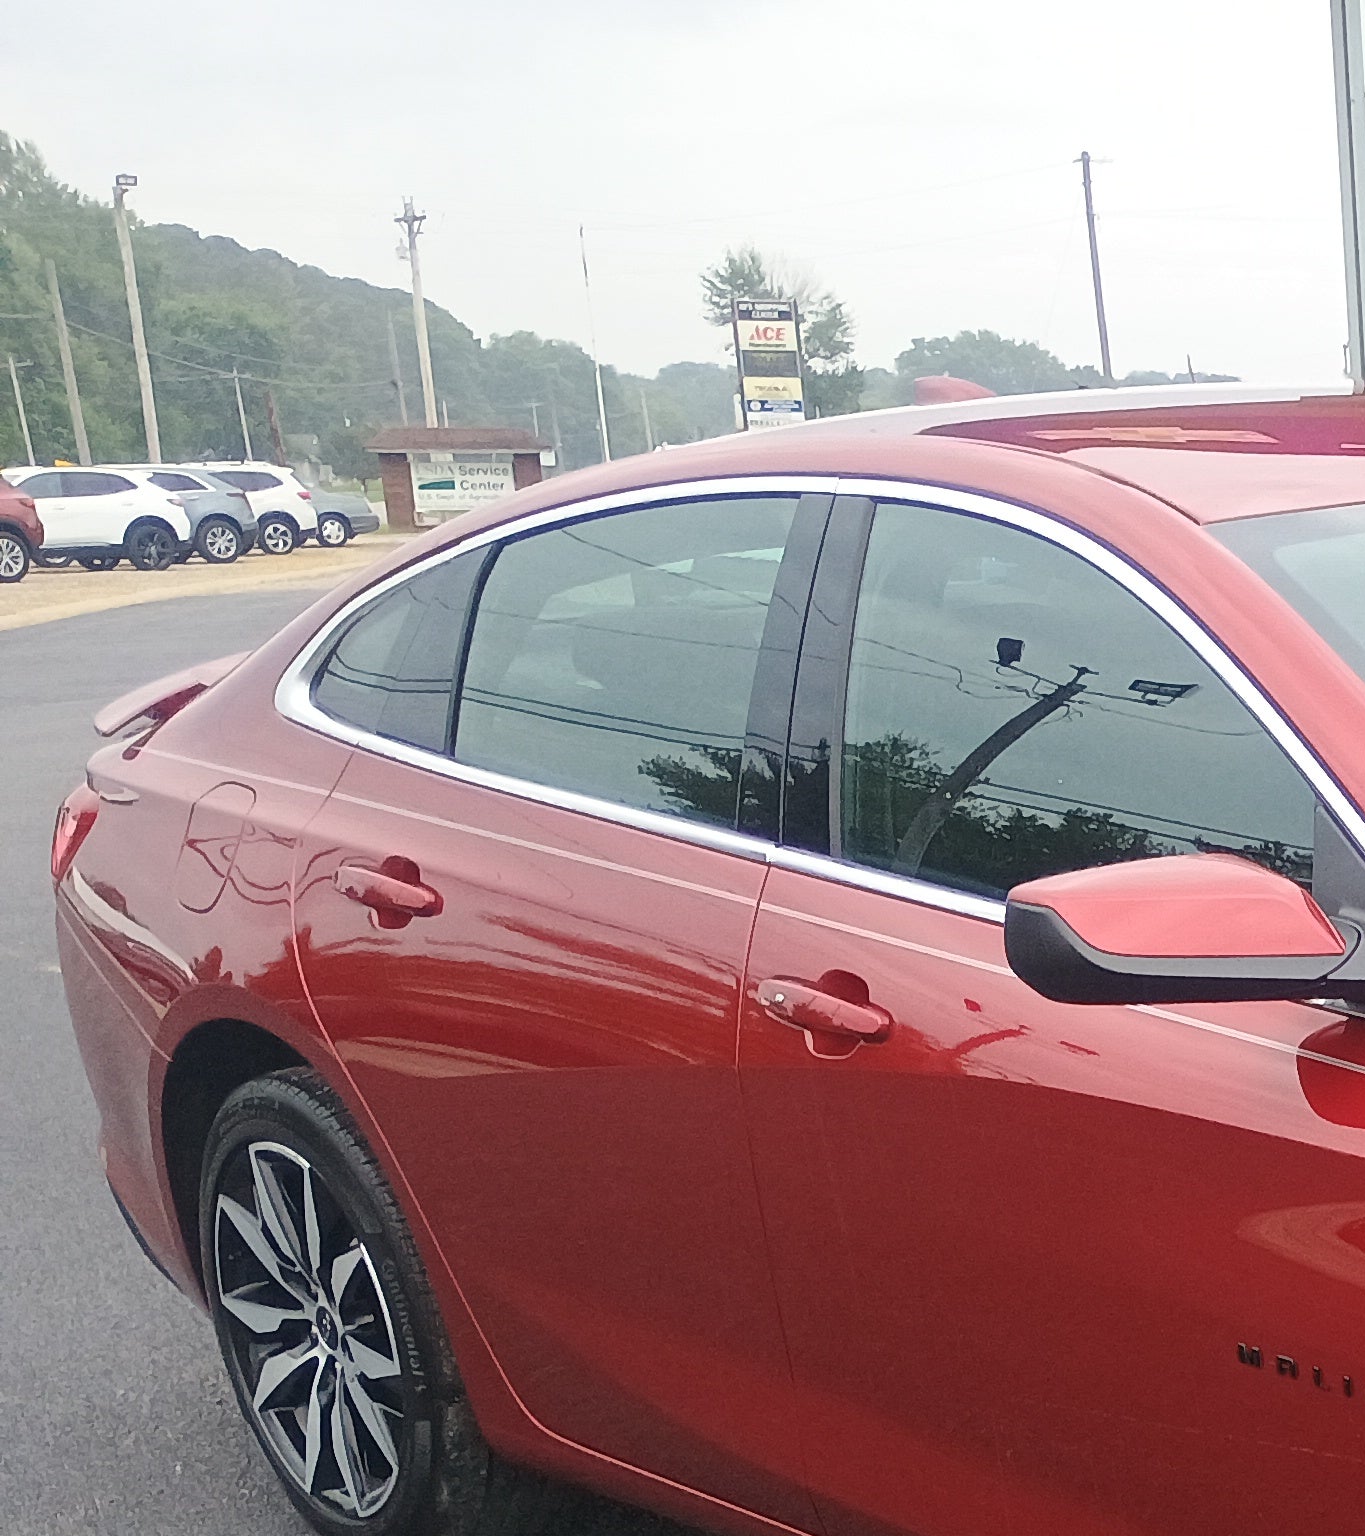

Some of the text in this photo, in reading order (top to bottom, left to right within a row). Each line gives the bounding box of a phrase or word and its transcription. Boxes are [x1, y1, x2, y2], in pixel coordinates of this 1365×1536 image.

[748, 325, 786, 342] ACE
[458, 465, 509, 476] Service
[459, 480, 505, 491] Center
